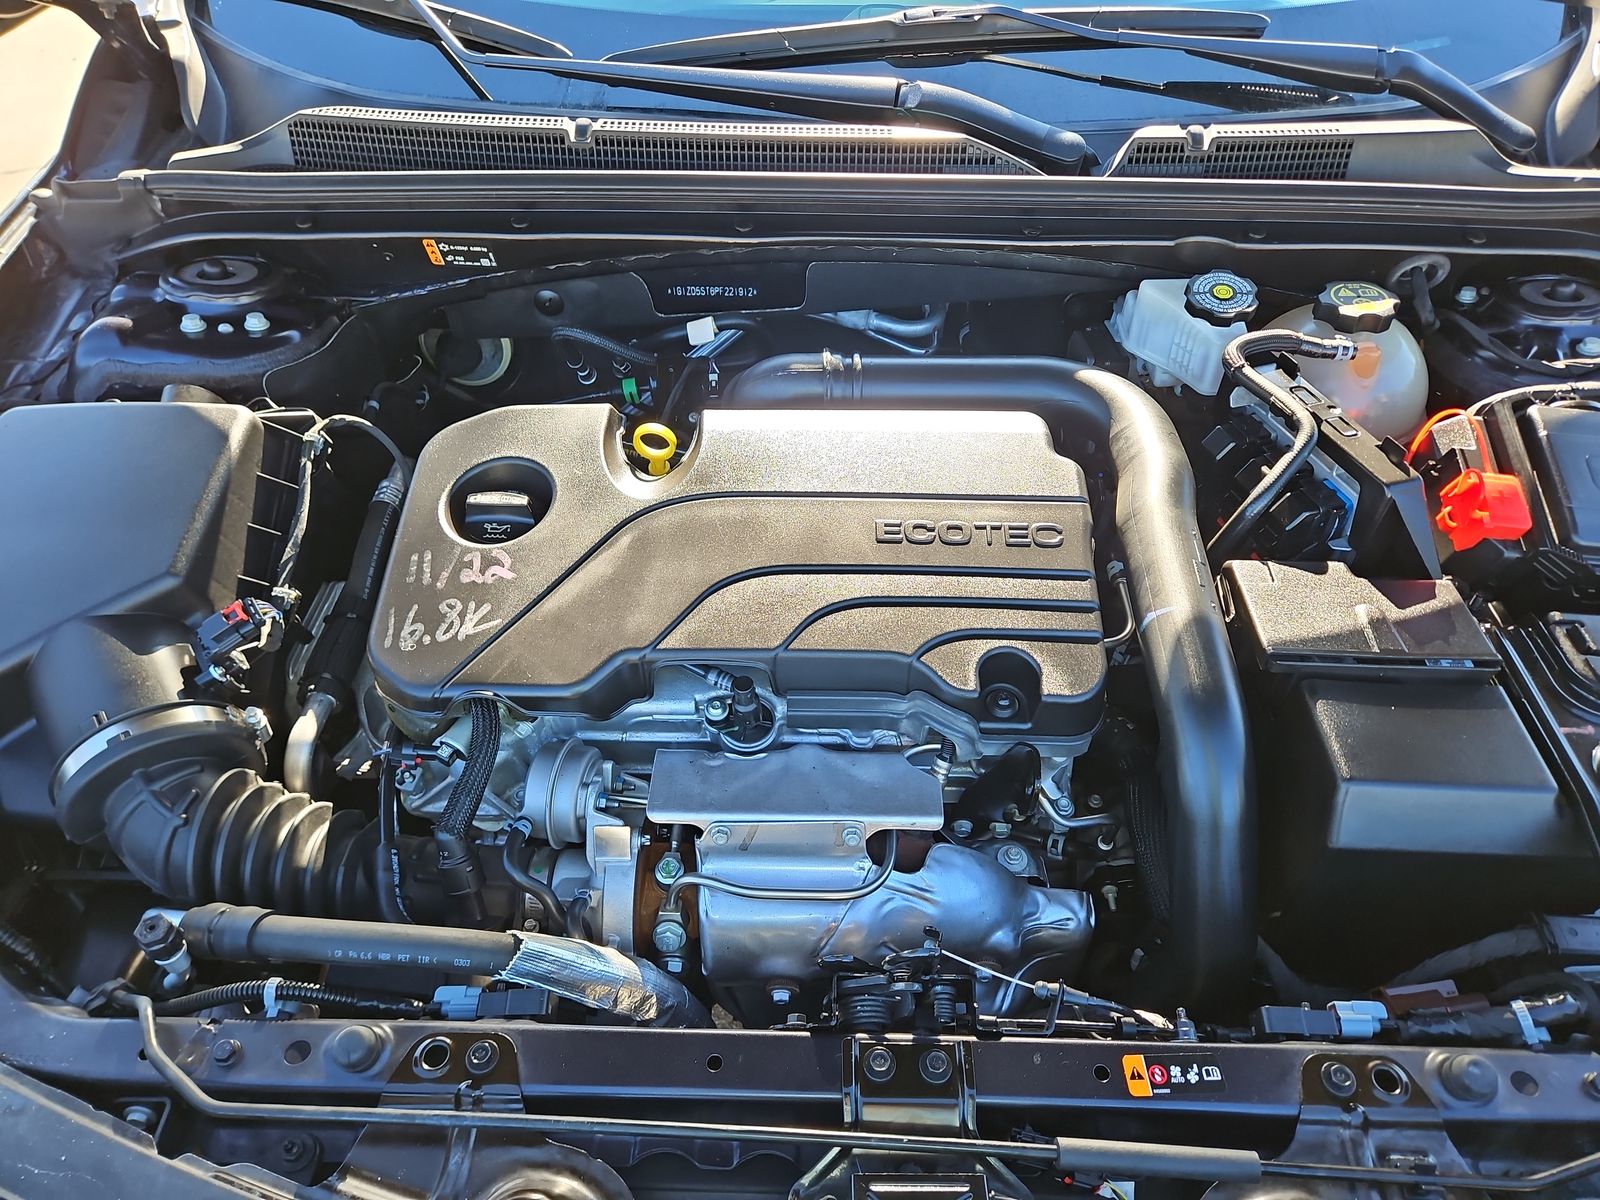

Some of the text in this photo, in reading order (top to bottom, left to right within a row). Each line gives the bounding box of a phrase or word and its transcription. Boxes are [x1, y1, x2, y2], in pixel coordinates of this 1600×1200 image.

[874, 519, 1064, 548] ECOTEC
[404, 546, 518, 590] 11/22
[384, 598, 503, 651] 16.8K
[397, 953, 410, 962] PET
[453, 958, 471, 967] 0303
